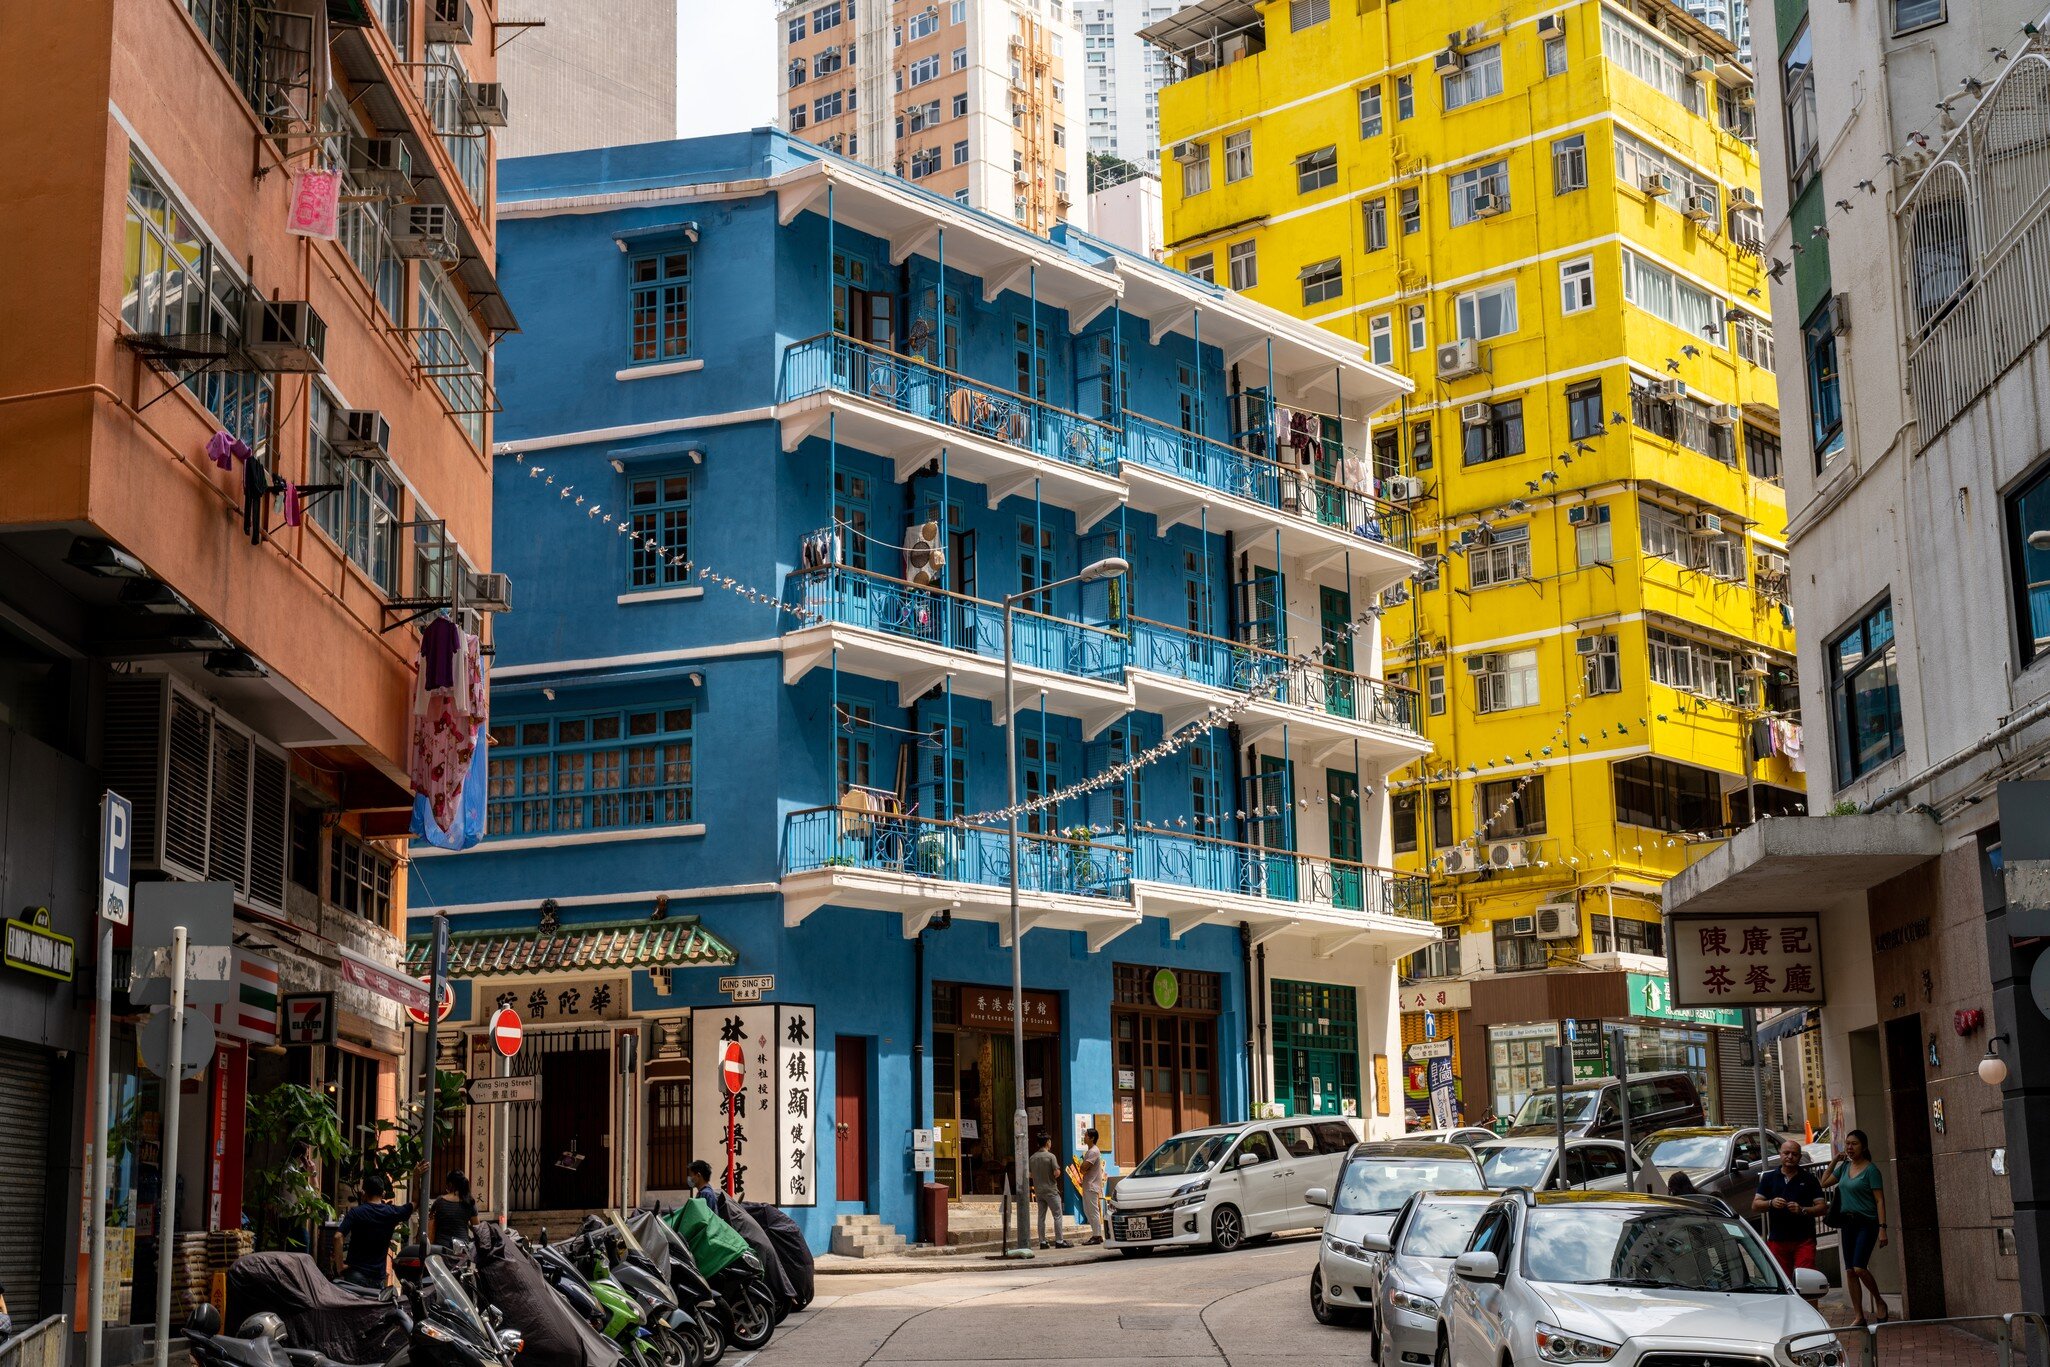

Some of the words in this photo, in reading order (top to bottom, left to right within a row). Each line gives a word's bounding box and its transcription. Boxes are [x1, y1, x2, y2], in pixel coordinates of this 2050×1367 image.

[109, 801, 127, 874] P
[438, 924, 447, 970] P
[1699, 926, 1812, 956] 陳廣記
[723, 980, 739, 989] KING
[742, 979, 758, 988] SING
[761, 978, 771, 987] ST
[1702, 963, 1816, 995] 茶餐廳
[292, 1021, 321, 1029] ELEVEN
[970, 1013, 985, 1021] Hong
[987, 1014, 1001, 1022] Kong
[494, 1080, 509, 1088] Sing
[511, 1079, 532, 1087] Street
[492, 1090, 518, 1100] 景星街
[786, 1014, 810, 1196] 林鎮顯健身院
